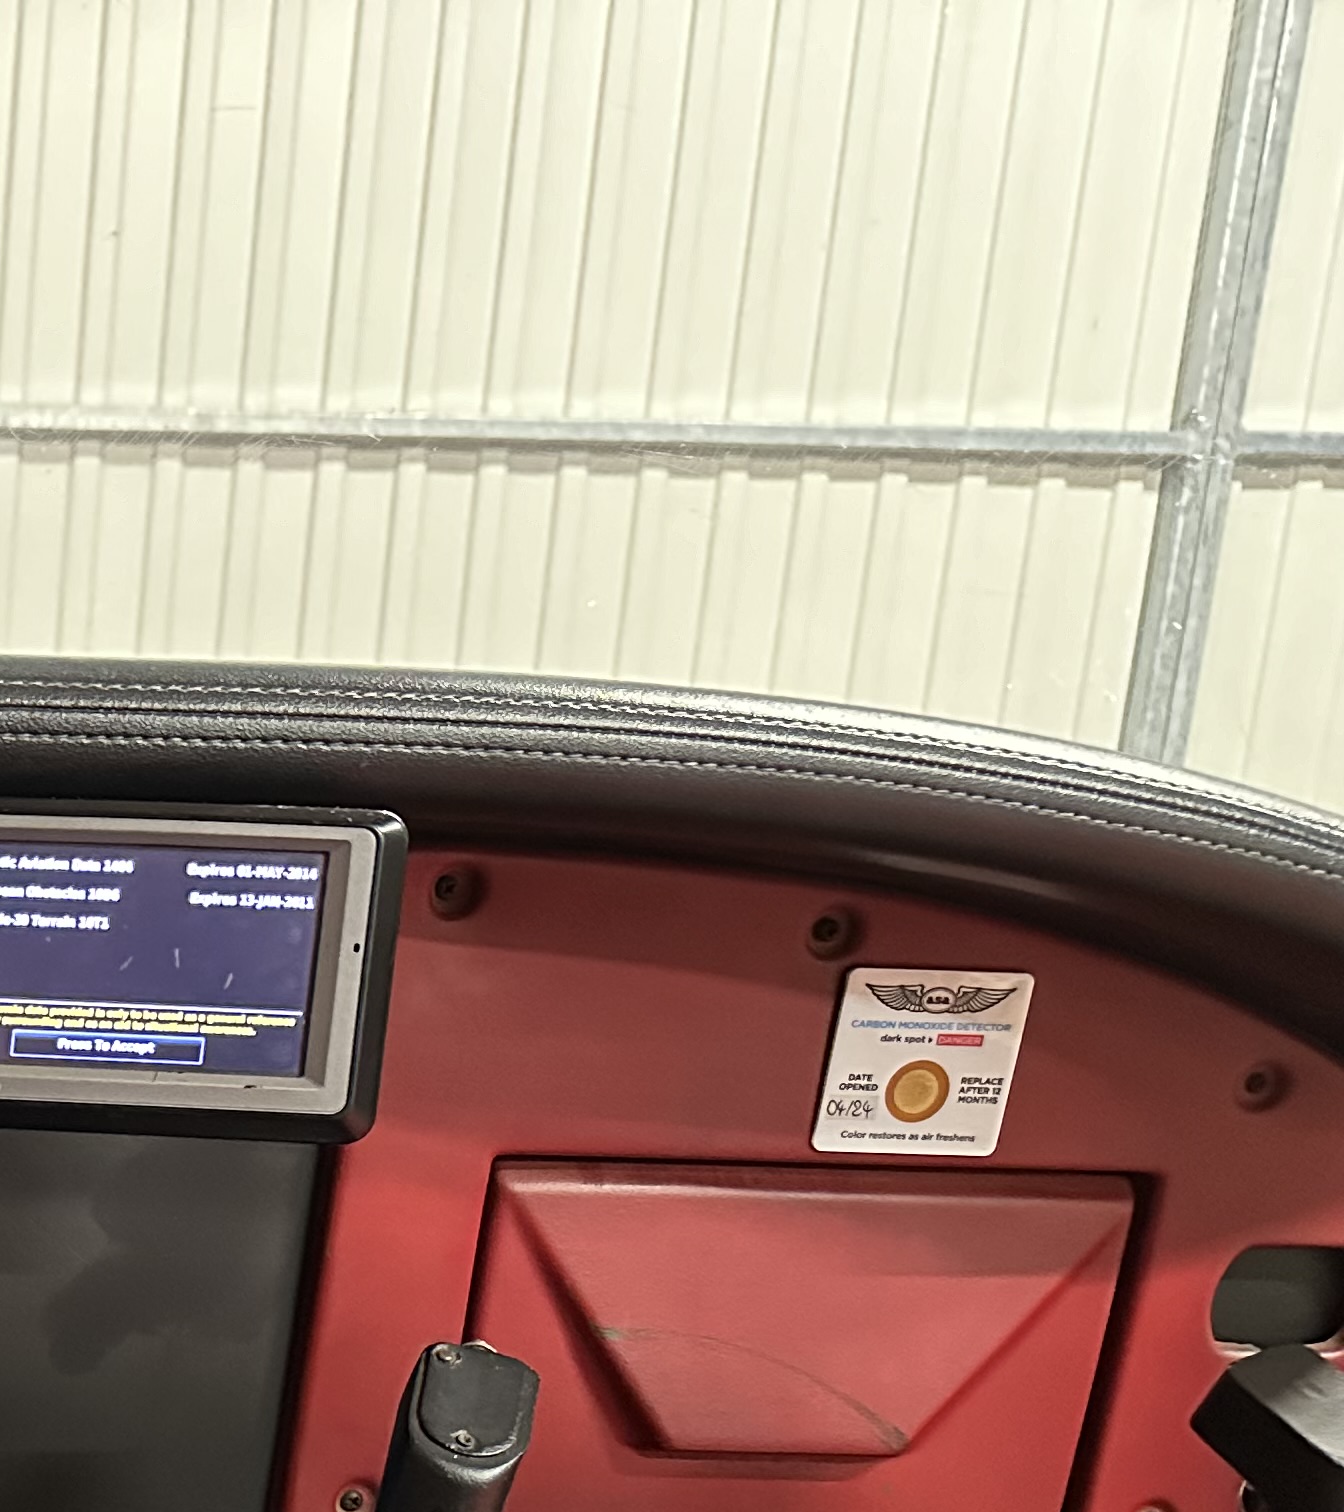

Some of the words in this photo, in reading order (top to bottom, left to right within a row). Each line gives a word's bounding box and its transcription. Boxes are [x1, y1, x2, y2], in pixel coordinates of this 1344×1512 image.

[852, 1020, 896, 1028] CARBON
[898, 1021, 953, 1030] MONOXIDE
[956, 1023, 1011, 1031] DETECTOR
[904, 1035, 925, 1043] spot
[57, 1038, 92, 1051] Press
[95, 1039, 110, 1051] To
[111, 1040, 156, 1055] Accept
[839, 1083, 878, 1091] OPENED
[827, 1100, 873, 1118] 04/24
[869, 1132, 905, 1140] restores
[936, 1133, 974, 1142] freshens
